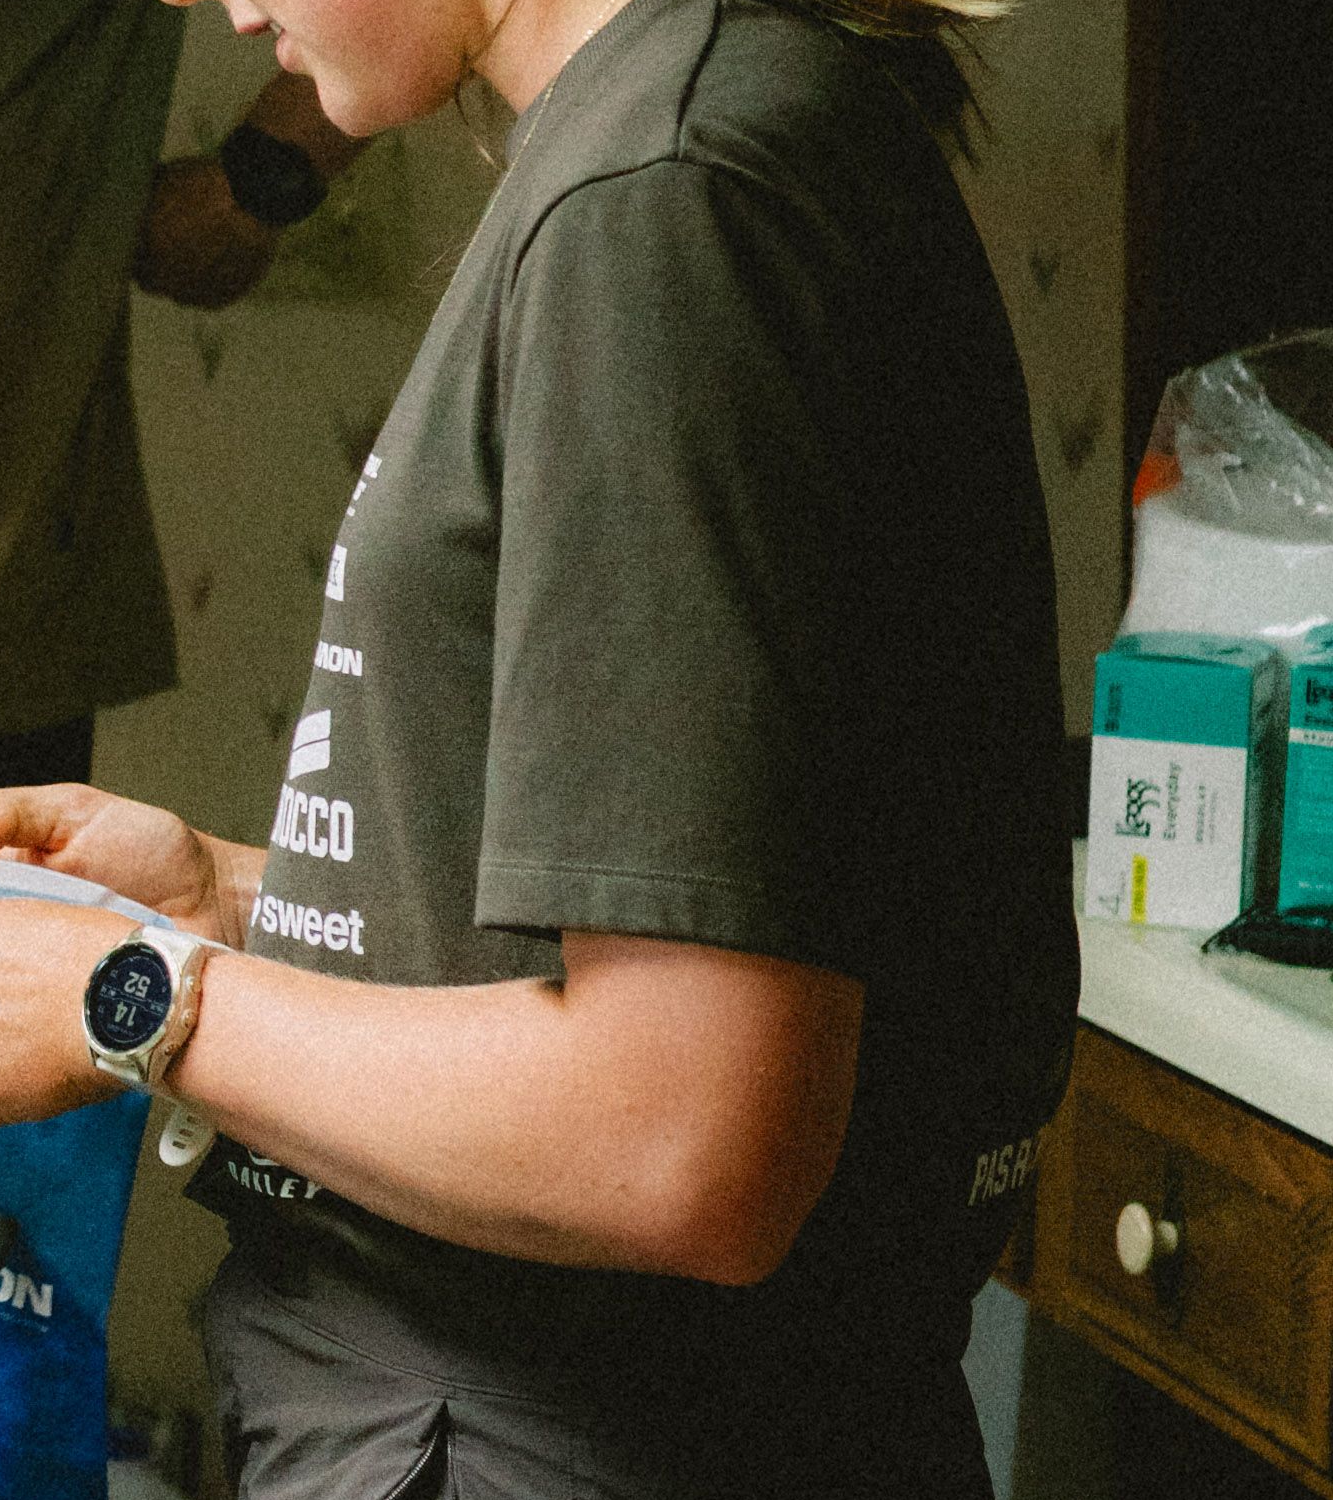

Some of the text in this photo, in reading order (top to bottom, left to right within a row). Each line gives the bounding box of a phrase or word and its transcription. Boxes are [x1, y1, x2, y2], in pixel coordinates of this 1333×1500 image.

[261, 895, 365, 955] sweet
[124, 971, 151, 998] 52
[114, 1000, 137, 1027] 14
